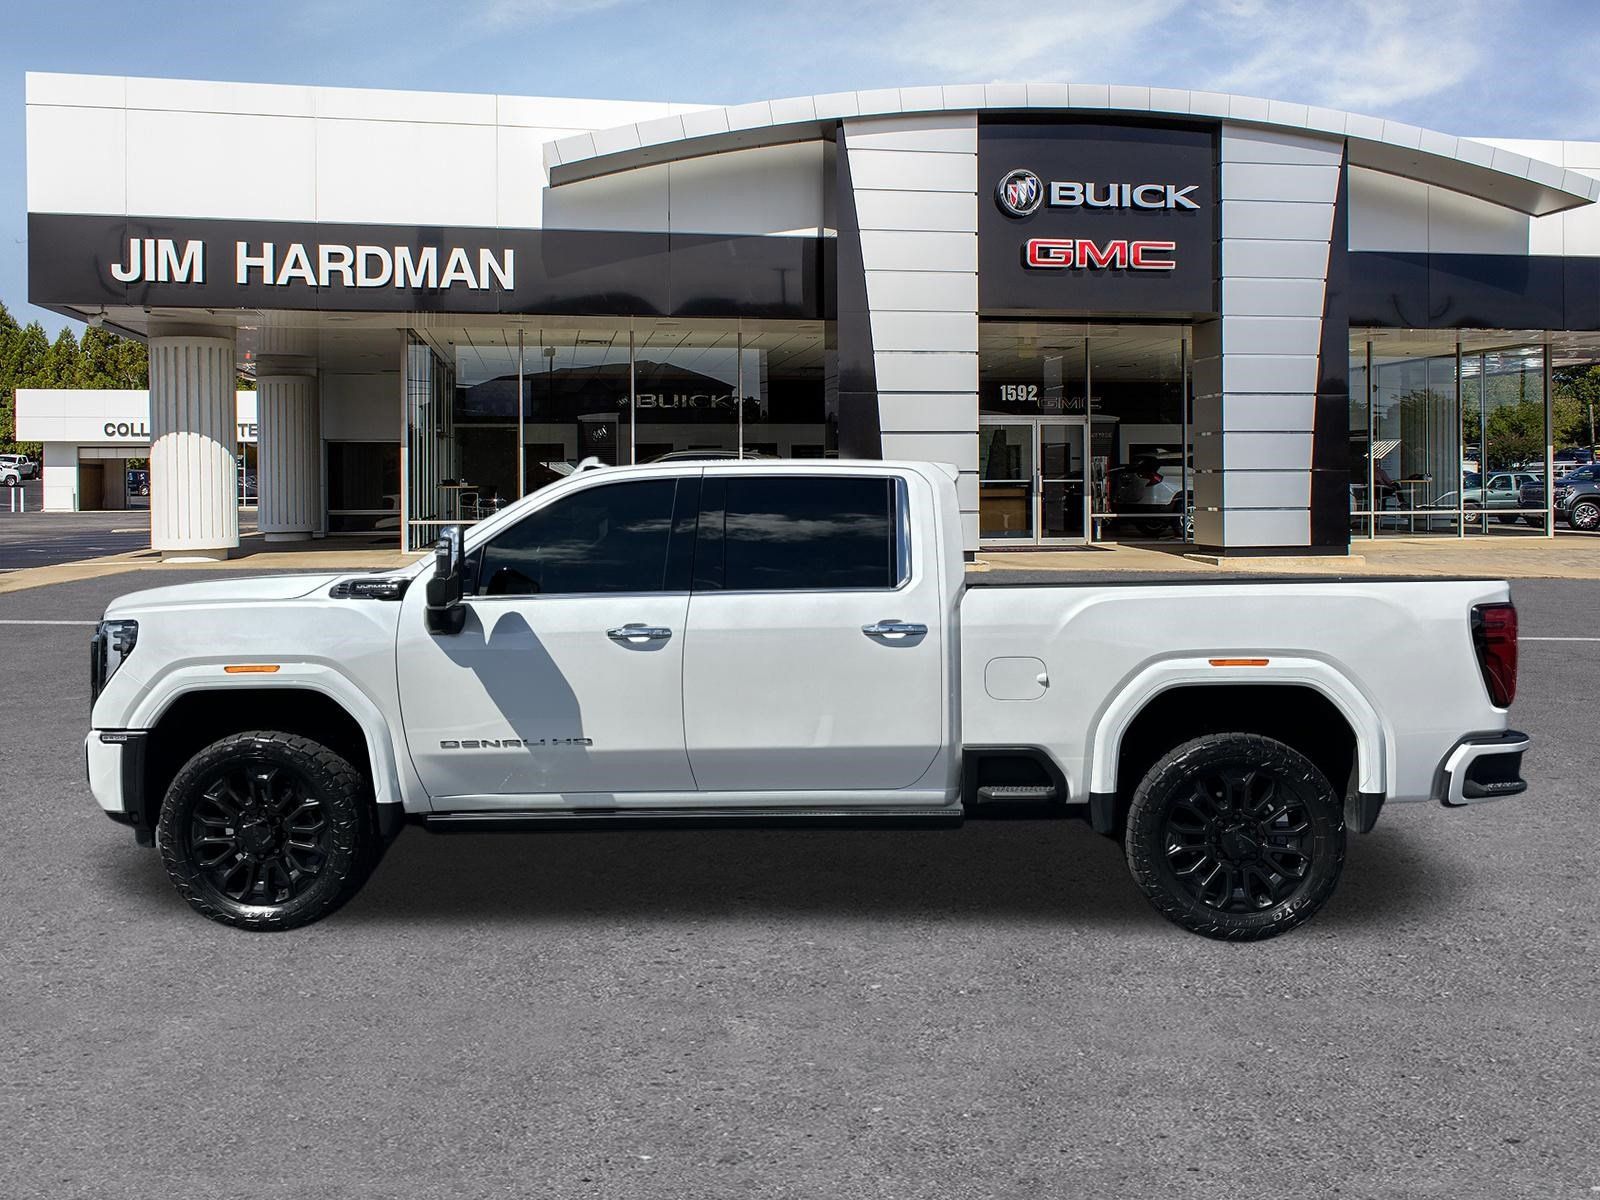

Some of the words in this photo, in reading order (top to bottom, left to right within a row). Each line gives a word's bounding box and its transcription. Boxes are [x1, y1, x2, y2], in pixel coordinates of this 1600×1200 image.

[1050, 181, 1200, 209] BUICK
[1026, 238, 1176, 270] GMC
[111, 238, 204, 284] JIM
[236, 241, 515, 291] HARDMAN
[636, 394, 733, 408] BUICK
[1000, 384, 1038, 401] 1592
[1037, 397, 1102, 409] GMC
[440, 738, 546, 749] DENALI
[552, 738, 593, 747] HD
